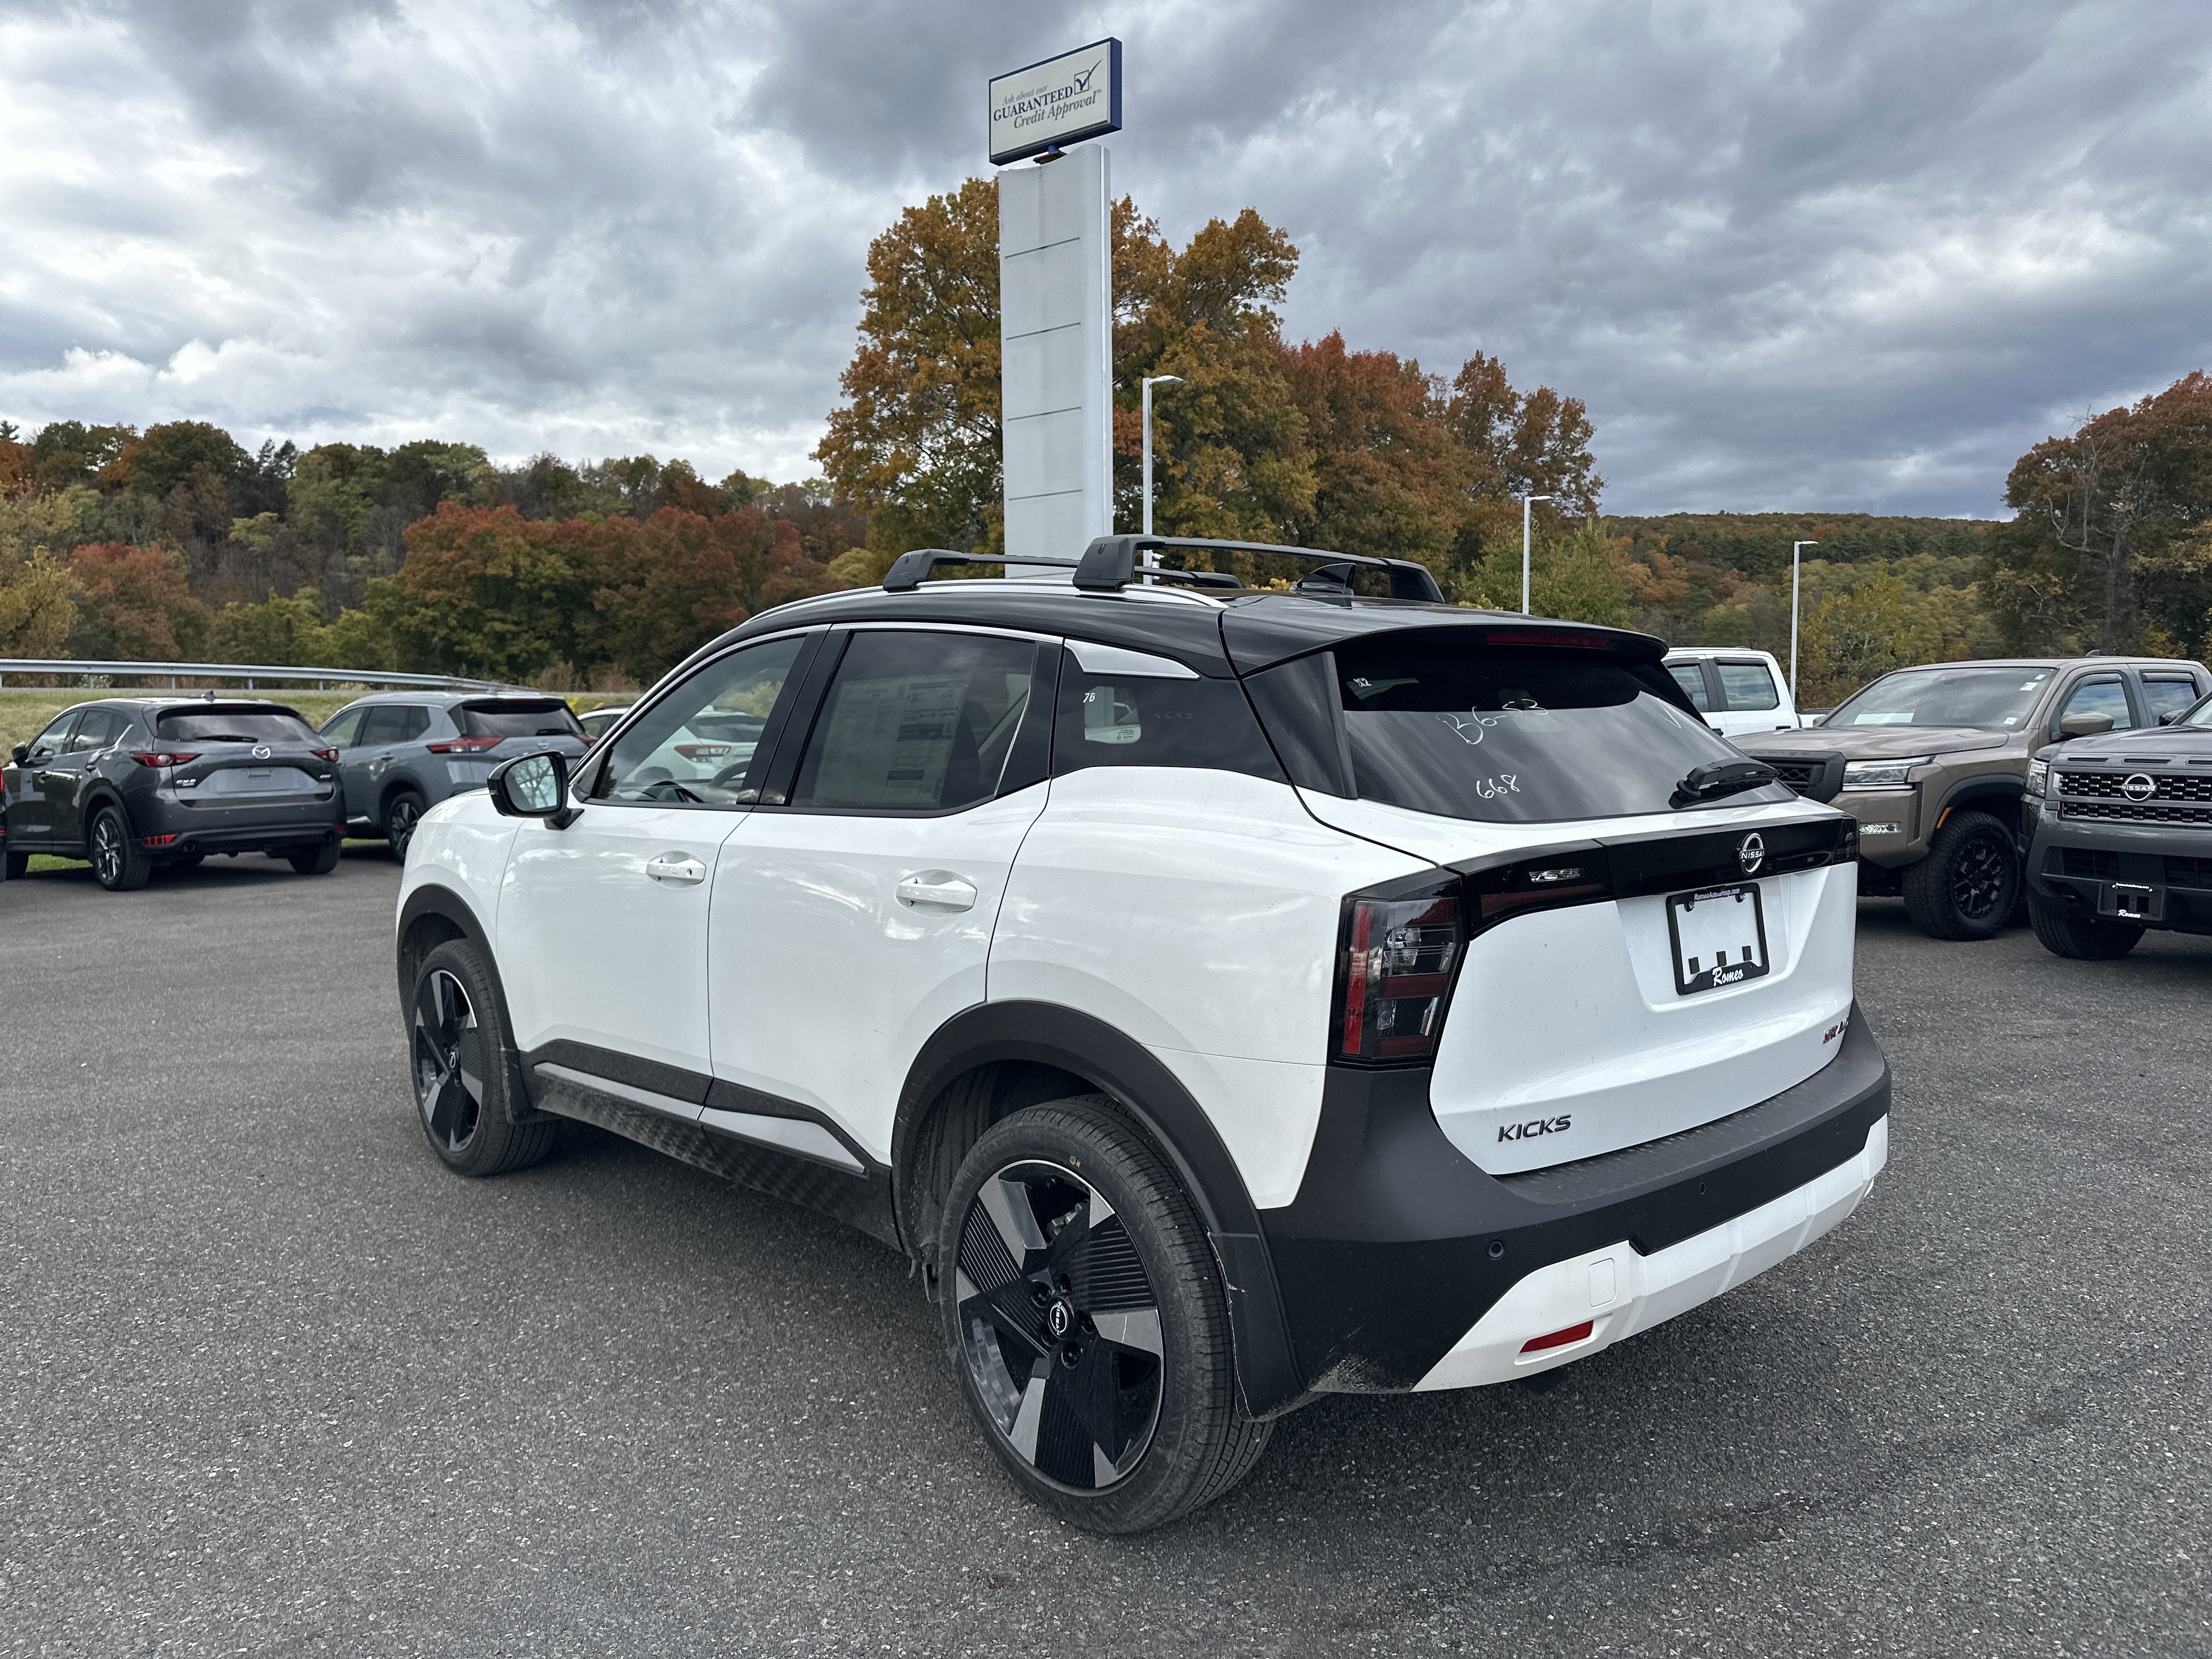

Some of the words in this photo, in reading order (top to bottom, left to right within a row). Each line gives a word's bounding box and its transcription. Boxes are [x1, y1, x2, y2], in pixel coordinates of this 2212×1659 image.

[994, 86, 1073, 121] GUARANTEED
[1002, 94, 1014, 106] Ask
[1016, 89, 1035, 101] about
[1036, 85, 1048, 94] our
[1014, 109, 1045, 128] Credit
[1047, 91, 1096, 121] Approval
[1476, 774, 1520, 799] 668
[2118, 909, 2141, 918] Romeo
[1712, 967, 1743, 987] Romeo
[1498, 1114, 1571, 1142] KICKS
